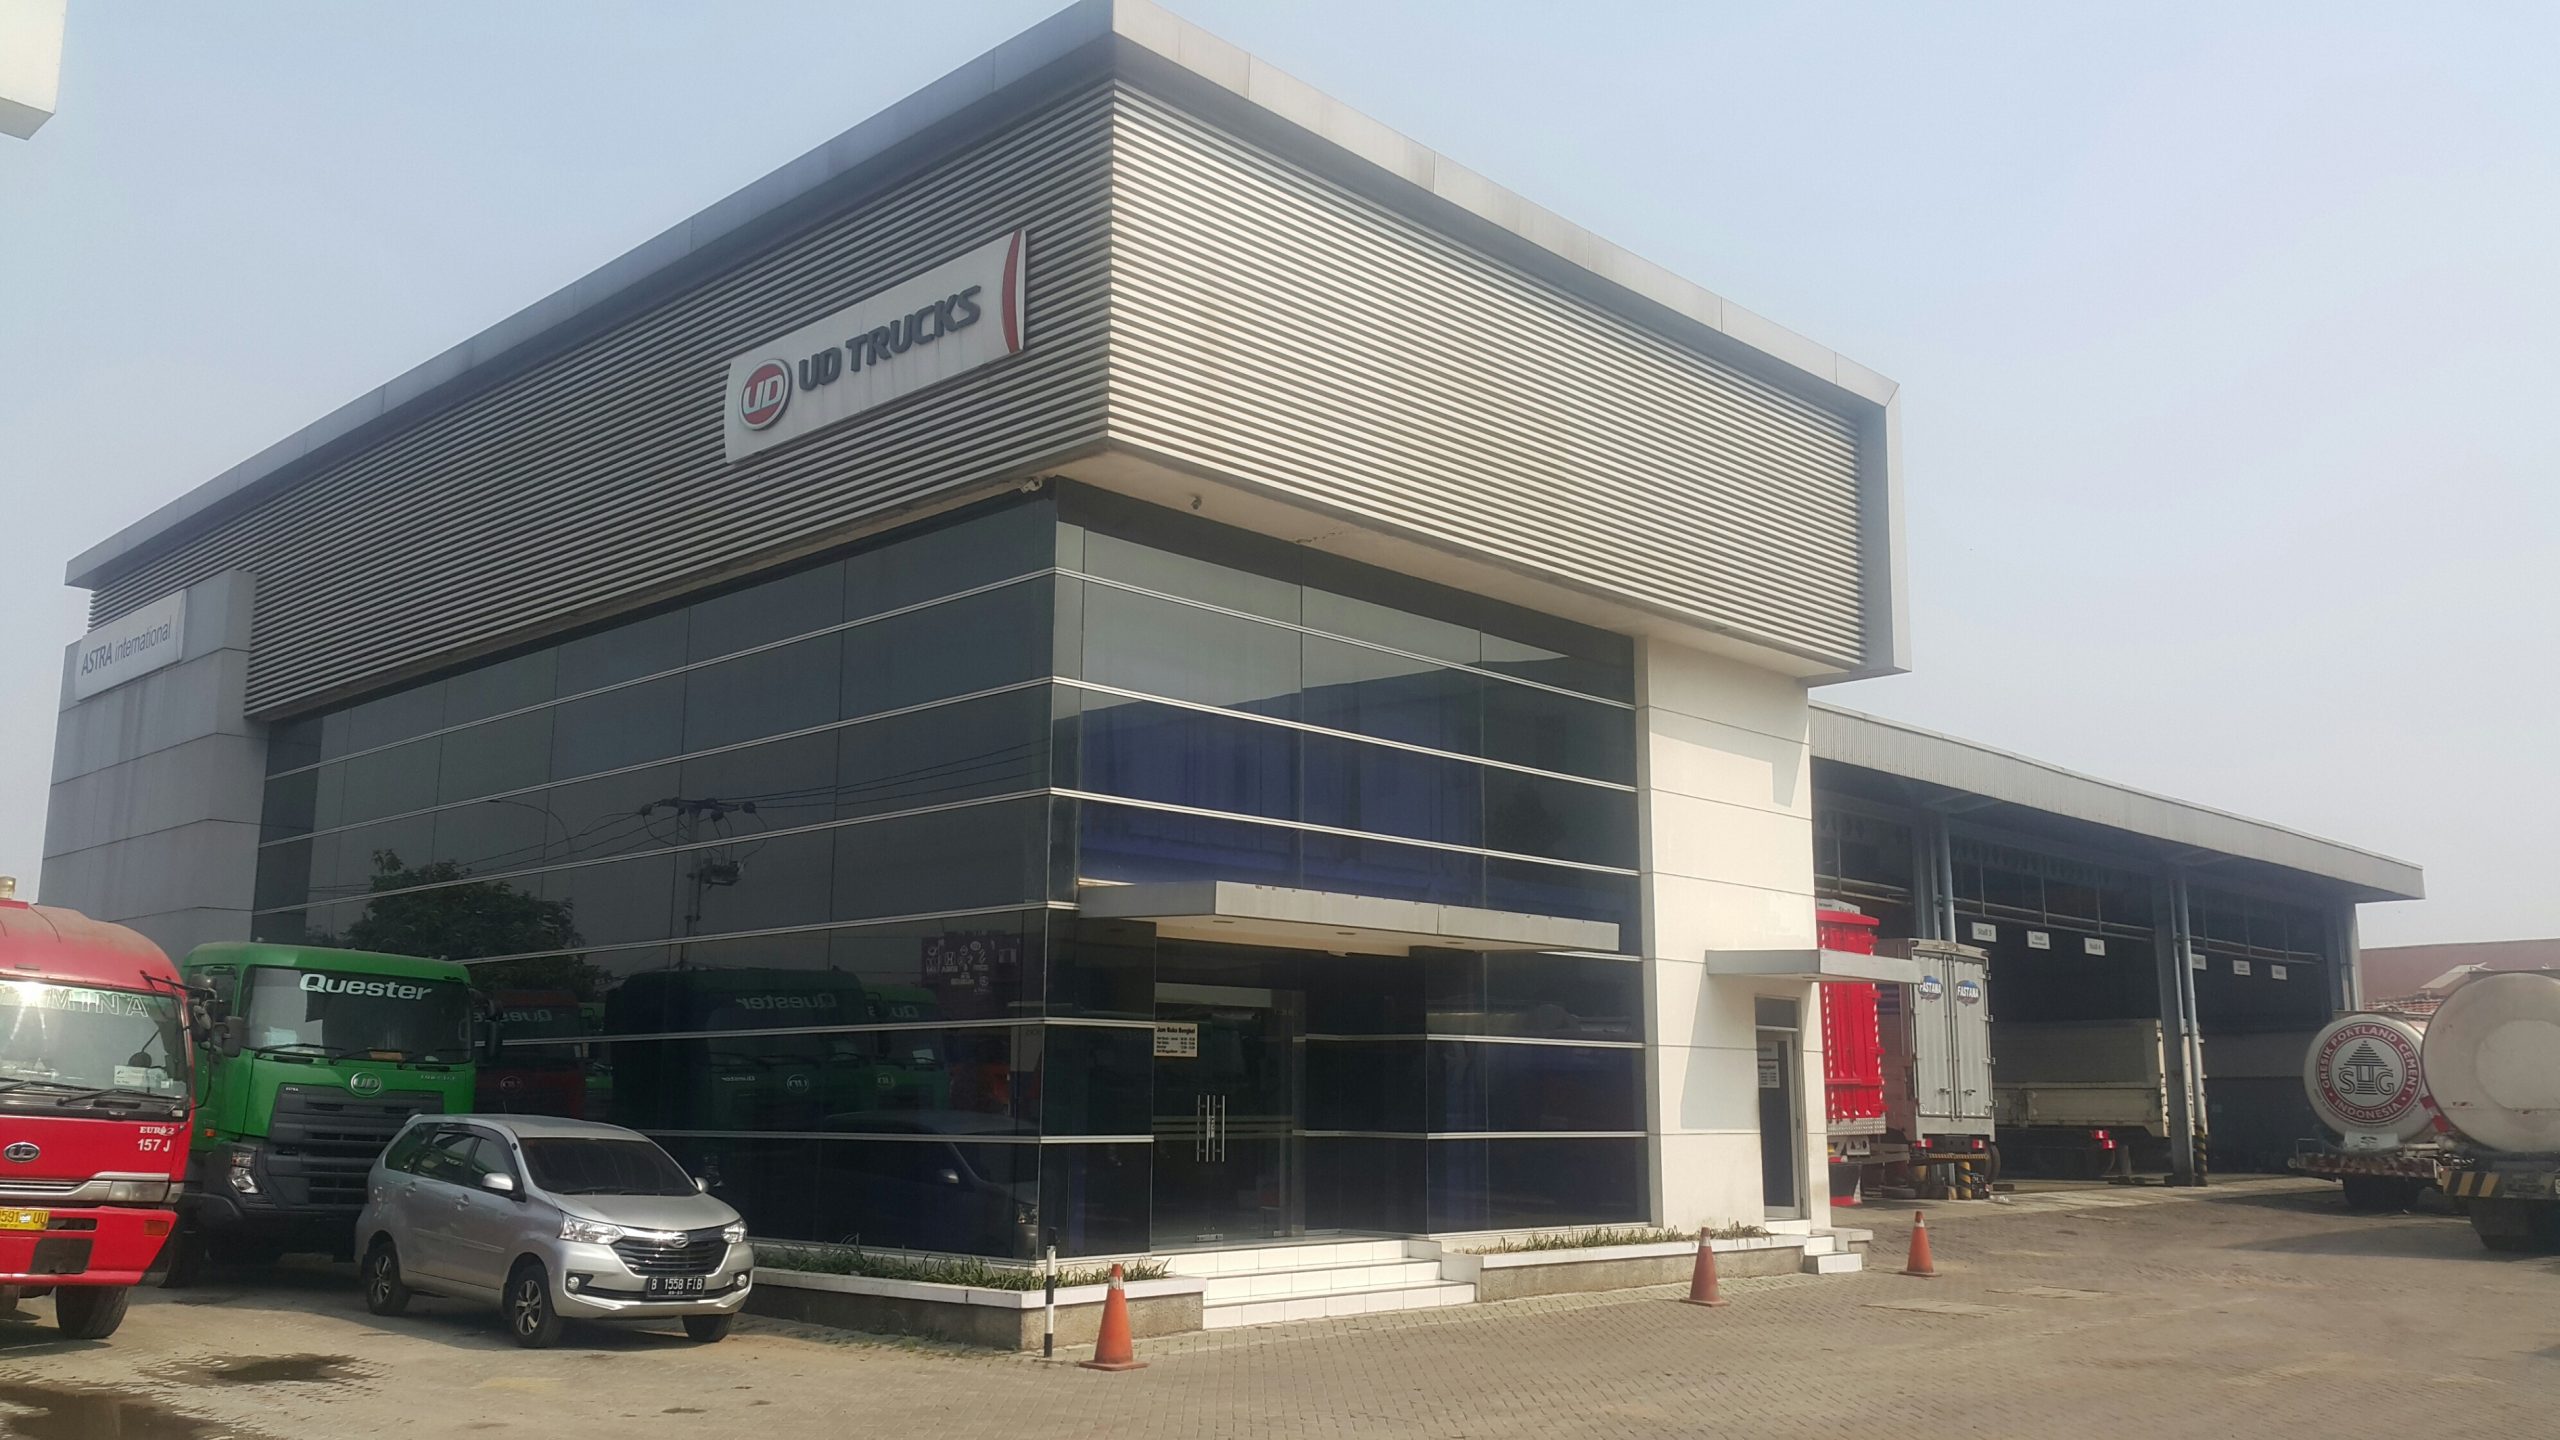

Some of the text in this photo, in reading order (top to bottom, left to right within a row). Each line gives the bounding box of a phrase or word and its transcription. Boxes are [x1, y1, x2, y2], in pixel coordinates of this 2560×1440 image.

[744, 285, 981, 413] UD UD TRUCKS
[81, 616, 172, 676] ASTRA international
[299, 973, 433, 1001] Quester
[2319, 1026, 2418, 1094] GRESIK PORTLAND CEMENT
[353, 1077, 380, 1088] UD
[2334, 1098, 2402, 1120] INDONESIA
[8, 1145, 38, 1159] UD
[137, 1138, 171, 1153] 157 J
[651, 1278, 703, 1290] B 1558 FIB
